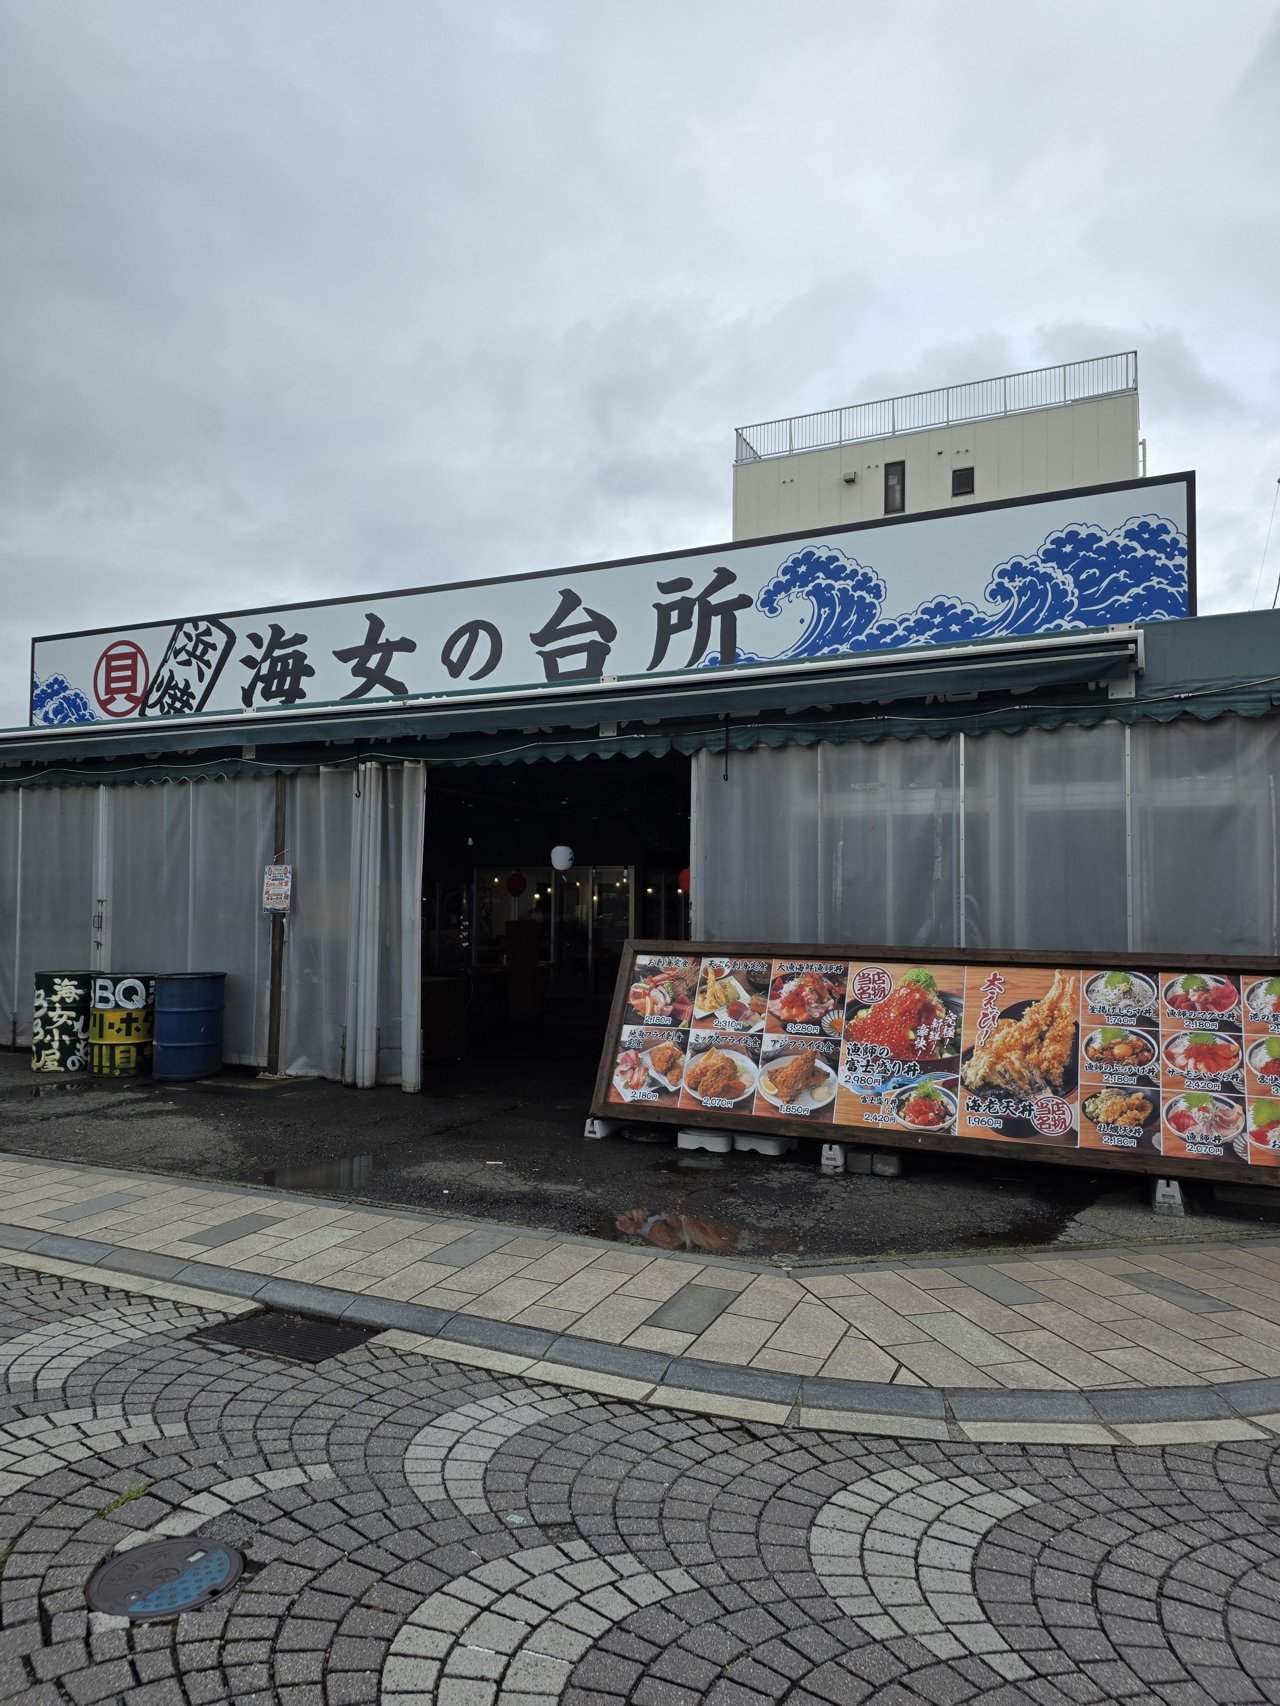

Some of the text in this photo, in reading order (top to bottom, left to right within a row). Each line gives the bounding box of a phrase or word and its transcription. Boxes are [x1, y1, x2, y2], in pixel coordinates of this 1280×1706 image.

[241, 567, 754, 706] 海女の台所
[1167, 1009, 1236, 1020] 漁師のマグロ丼
[41, 978, 85, 1072] 海女小屋
[770, 1038, 835, 1052] アジフライ定食
[847, 1042, 890, 1057] 漁師の
[846, 1058, 920, 1077] 富士盛り丼
[1167, 1068, 1241, 1081] サーモンいくら丼
[844, 1074, 881, 1086] 2,980円
[965, 1097, 1036, 1118] 海老天丼
[1186, 1132, 1222, 1144] 漁師丼
